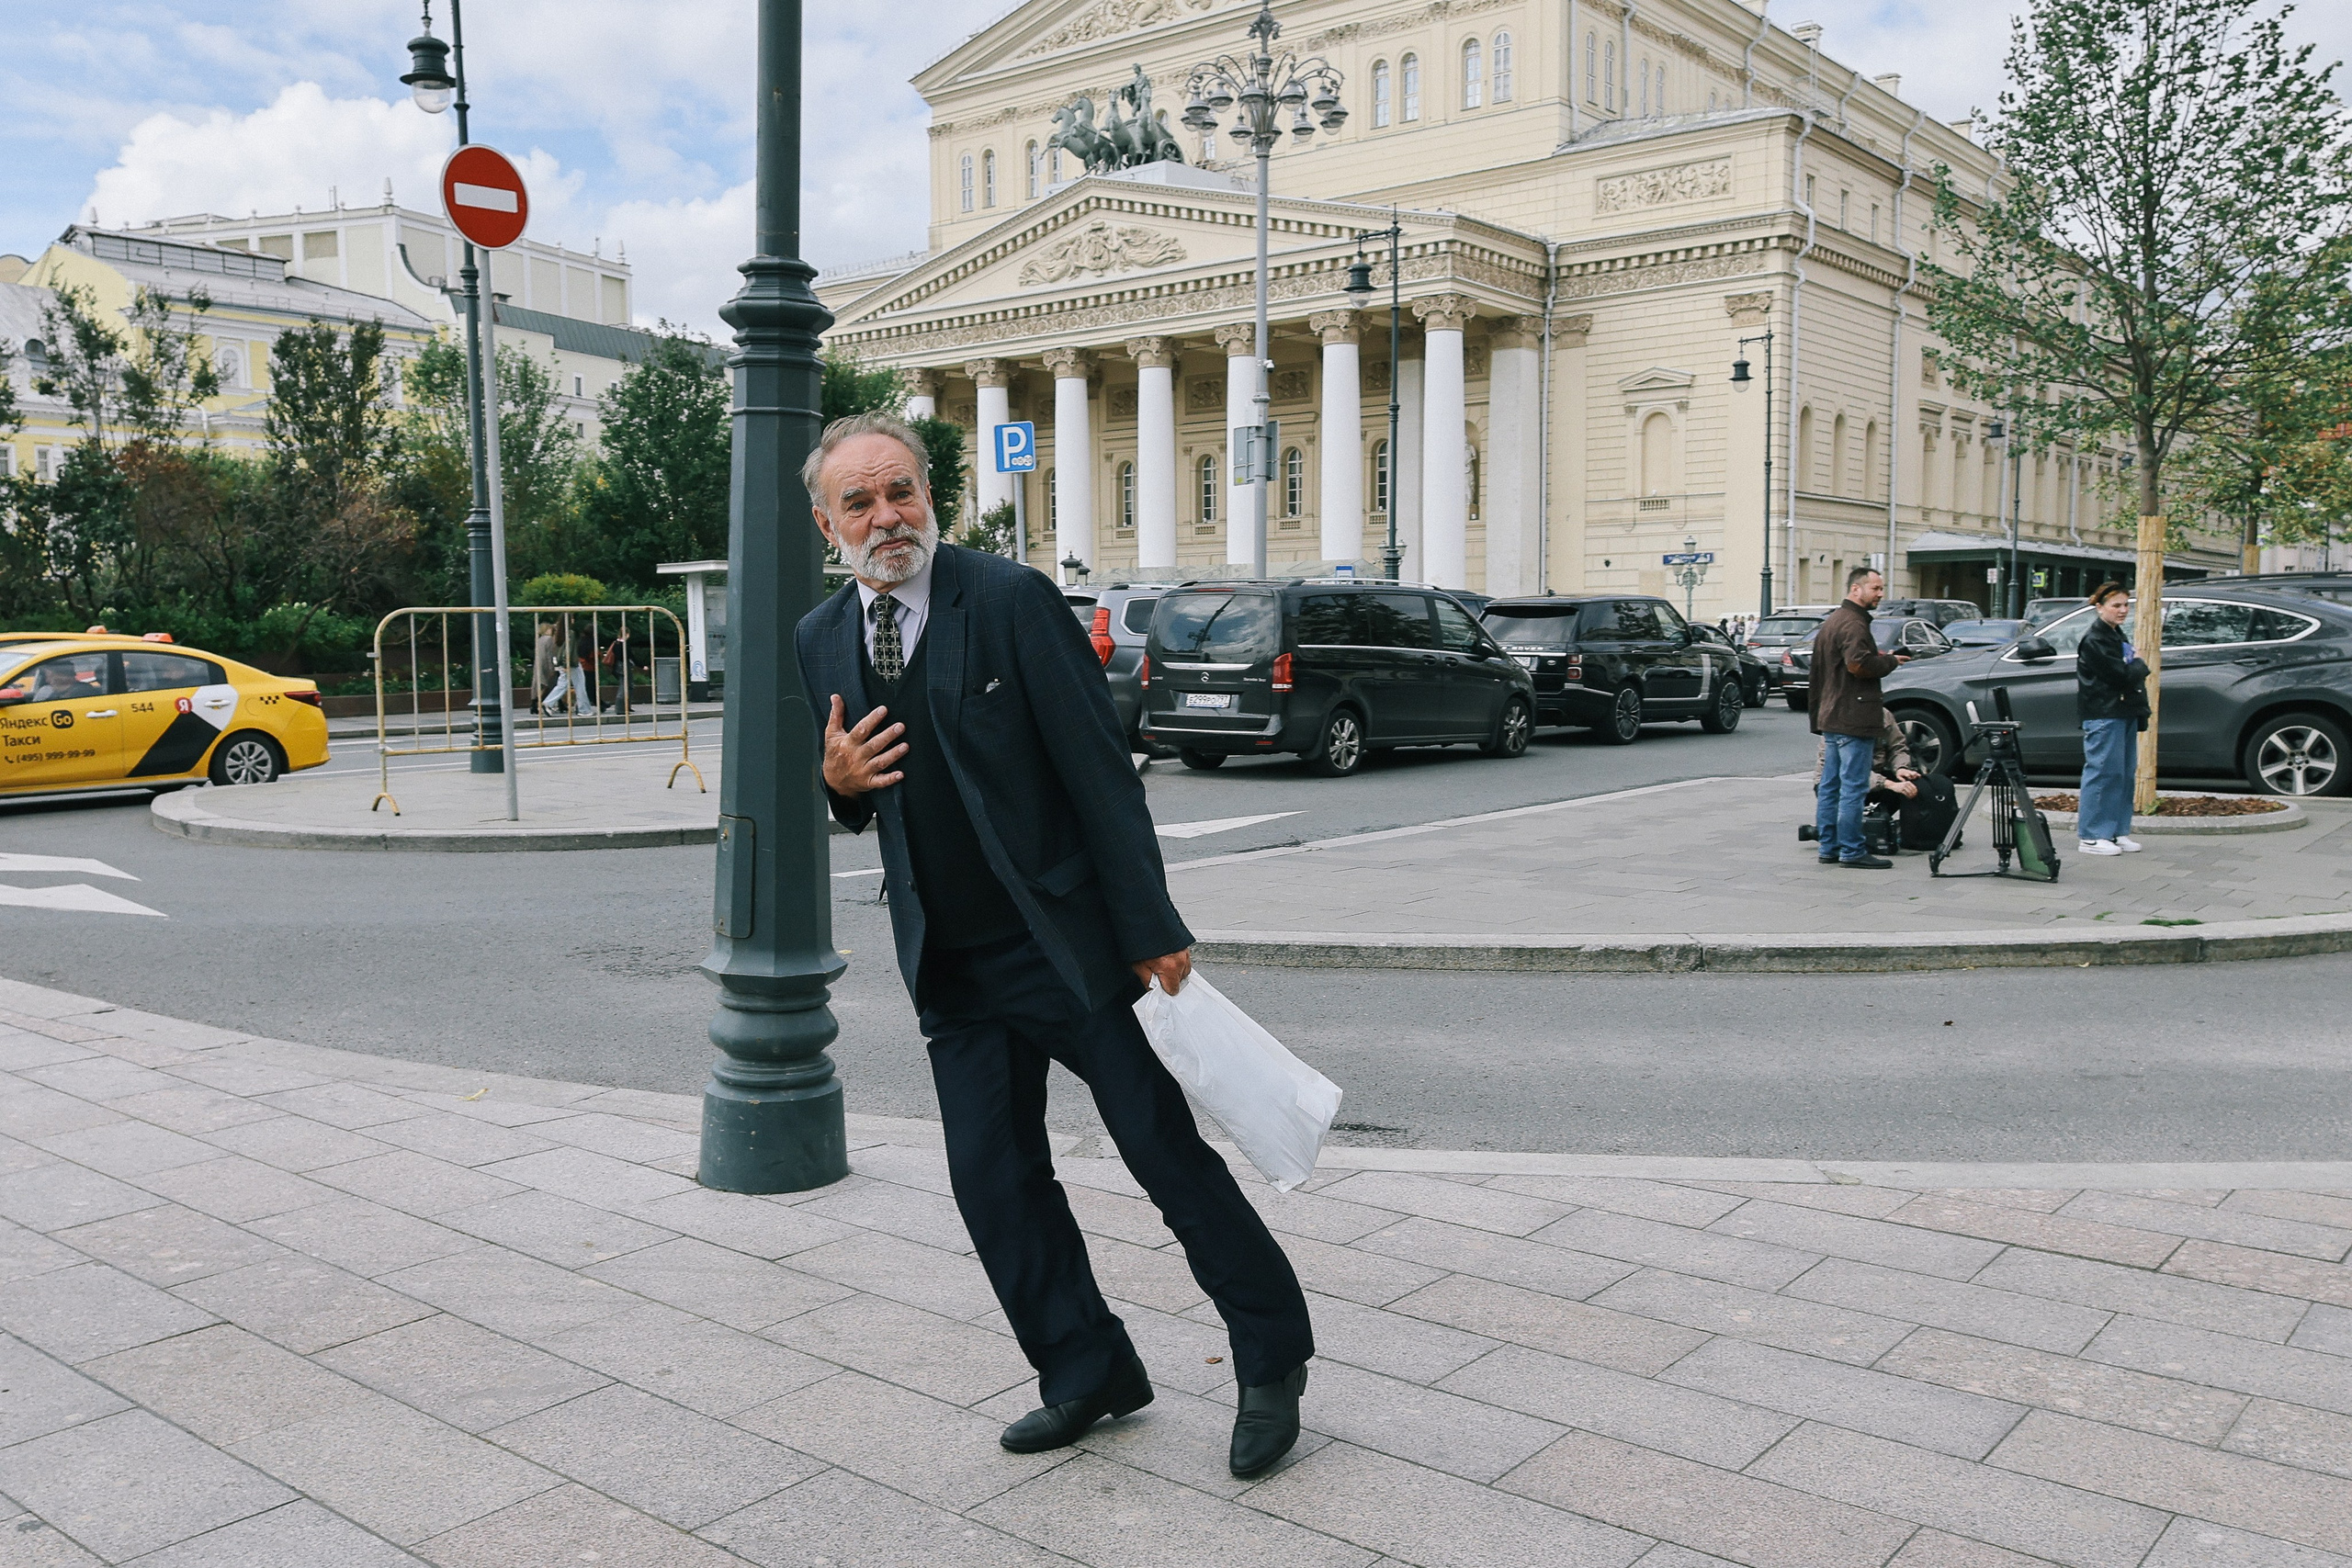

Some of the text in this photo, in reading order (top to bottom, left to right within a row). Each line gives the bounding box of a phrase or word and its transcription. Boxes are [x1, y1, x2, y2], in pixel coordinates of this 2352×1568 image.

[1001, 426, 1027, 468] P
[130, 702, 154, 713] 544
[178, 699, 189, 711] Я
[0, 713, 73, 729] Яндекс Go
[2, 735, 41, 747] Такси
[17, 749, 96, 763] (495) 999-99-99
